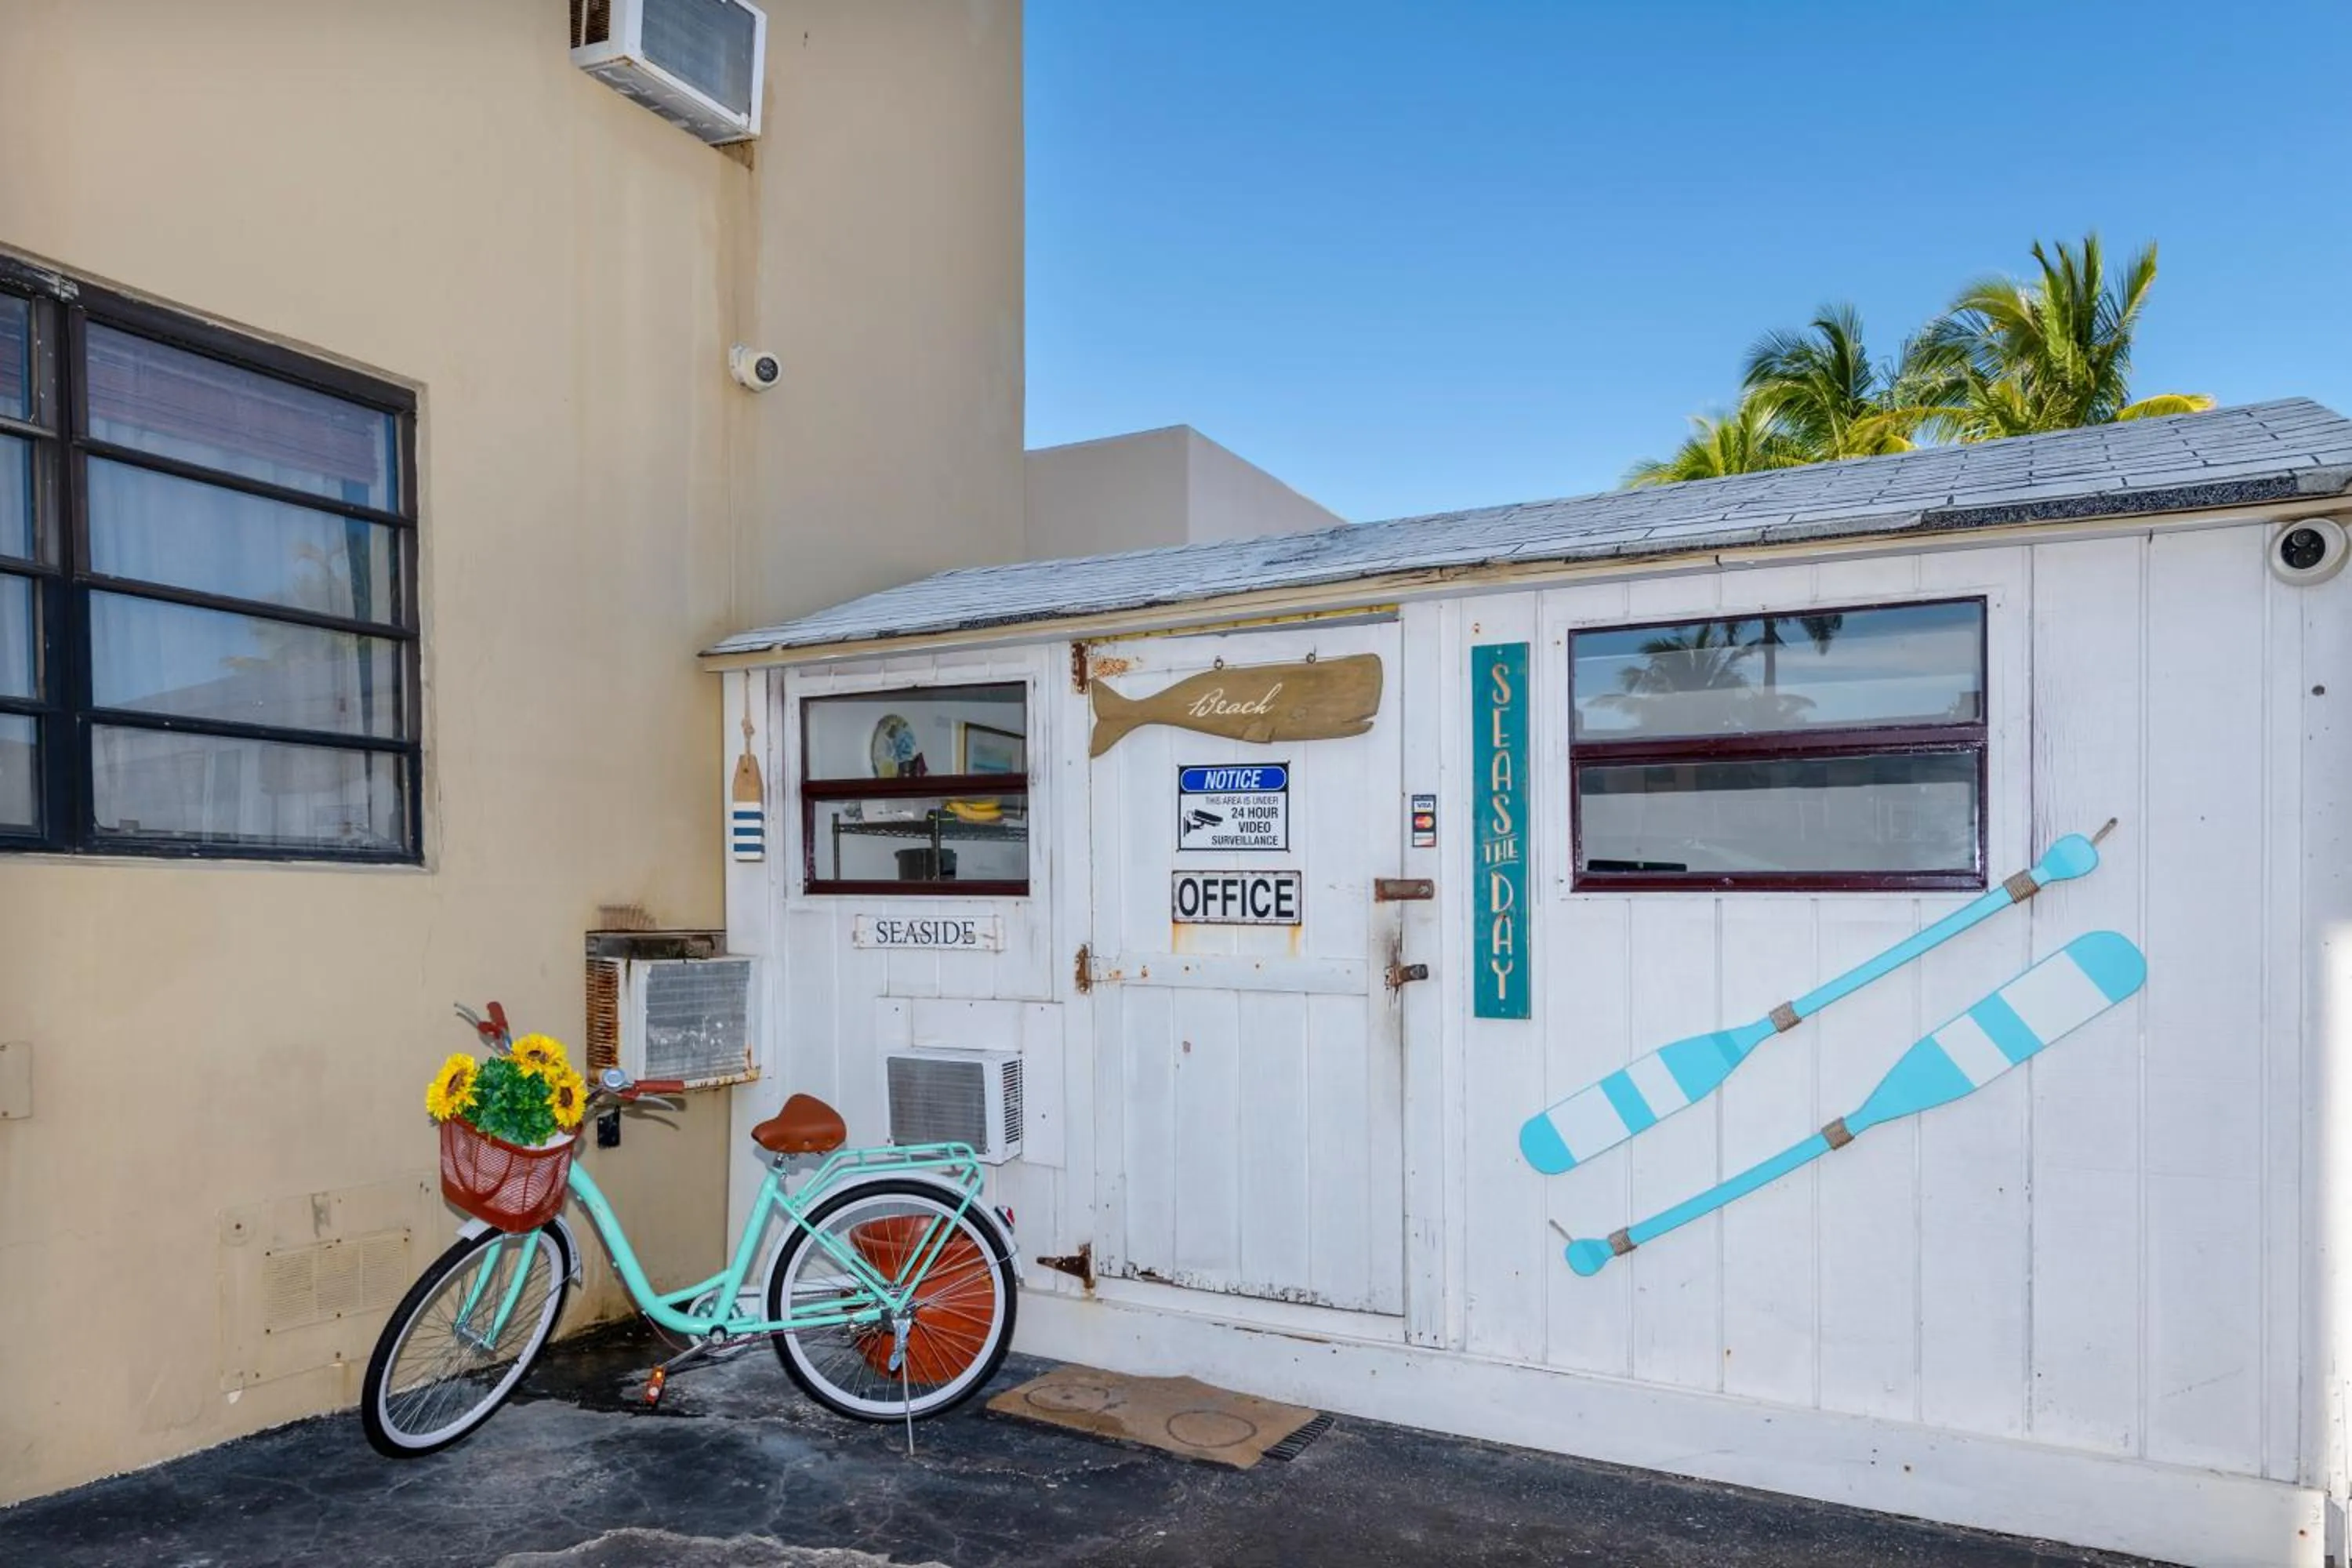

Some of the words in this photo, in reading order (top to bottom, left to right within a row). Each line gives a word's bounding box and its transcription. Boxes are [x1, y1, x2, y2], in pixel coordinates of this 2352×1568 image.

[1188, 682, 1283, 718] Beach
[1492, 664, 1512, 835] SEAS
[1203, 770, 1263, 789] NOTICE
[1223, 797, 1241, 805] AREA
[1243, 797, 1252, 805] IS
[1253, 797, 1279, 805] UNDER
[1231, 807, 1244, 819] 24
[1247, 807, 1279, 819] HOUR
[1239, 821, 1271, 833] VIDEO
[1211, 835, 1278, 846] SURVEILLANCE
[1484, 838, 1518, 863] THE
[1178, 877, 1294, 918] OFFICE
[876, 920, 976, 945] SEASIDE
[1491, 872, 1514, 1000] DAY
